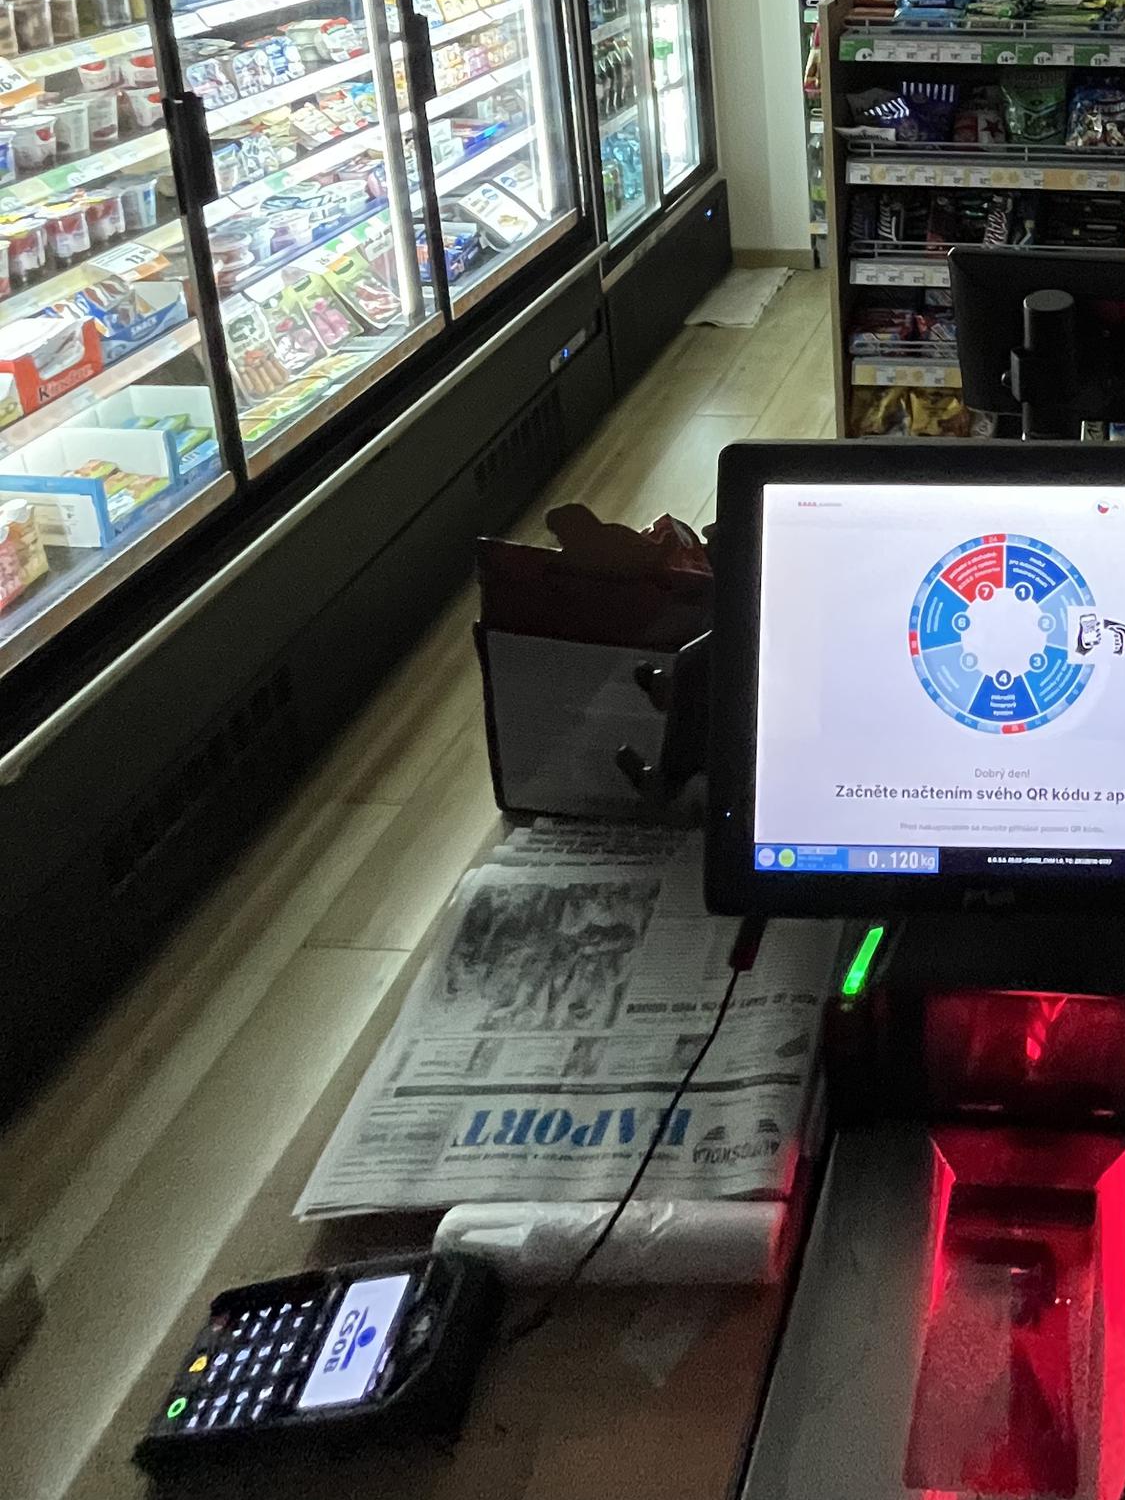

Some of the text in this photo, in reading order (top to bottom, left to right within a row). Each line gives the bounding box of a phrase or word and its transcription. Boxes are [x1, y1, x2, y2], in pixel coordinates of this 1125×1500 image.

[983, 587, 990, 597] 7
[1019, 587, 1026, 597] 1
[1033, 657, 1041, 666] 3
[999, 672, 1008, 682] 4
[974, 768, 1031, 780] Dobrý den!
[835, 784, 898, 799] Začněte
[901, 785, 972, 800] načtením
[976, 786, 1022, 801] svého
[1026, 788, 1048, 801] QR
[1052, 787, 1090, 802] kódu
[1093, 790, 1101, 802] z
